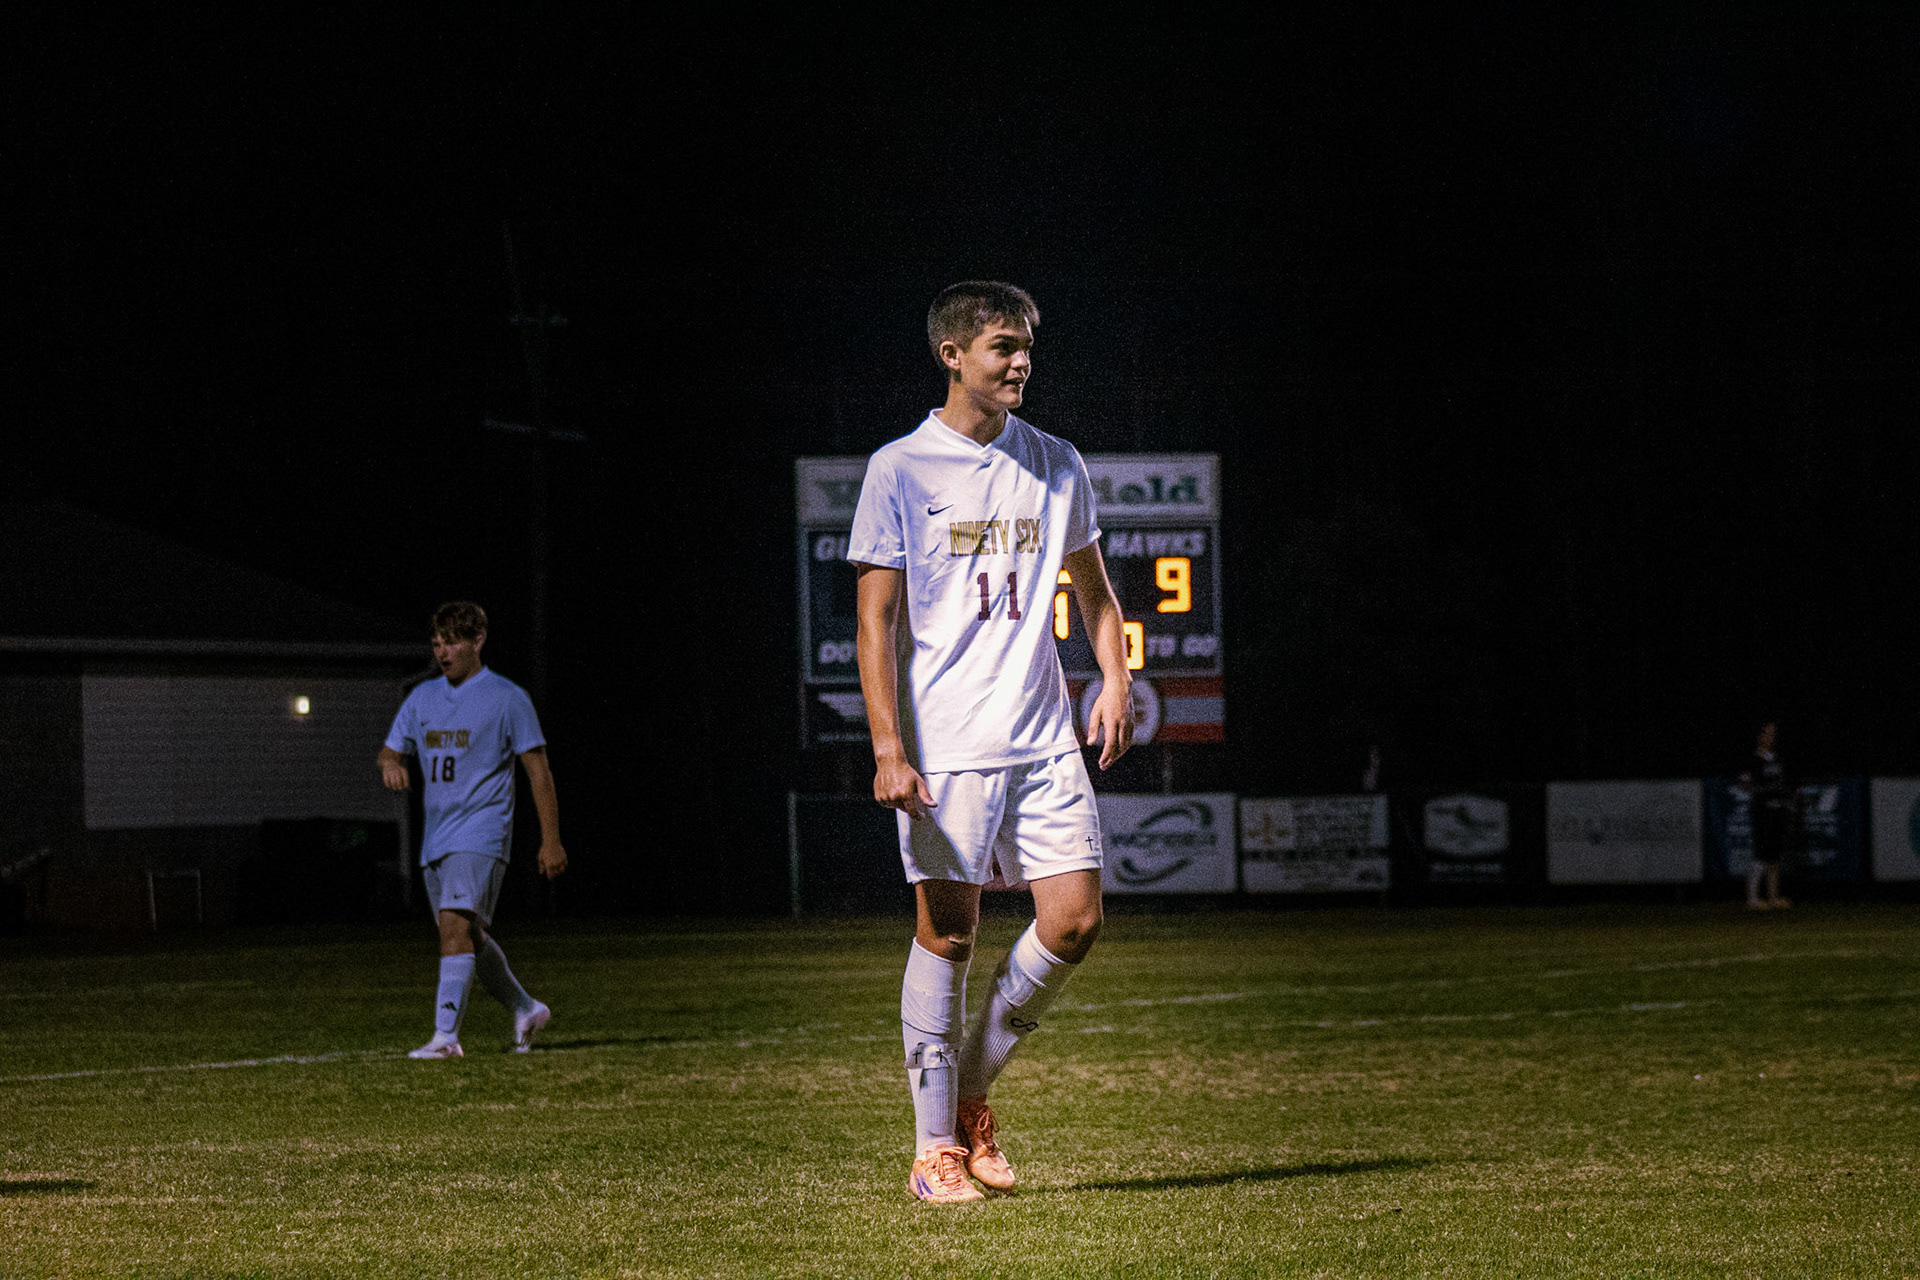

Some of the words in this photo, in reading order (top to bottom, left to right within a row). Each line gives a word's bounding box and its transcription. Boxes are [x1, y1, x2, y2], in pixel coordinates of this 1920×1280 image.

[949, 520, 1010, 557] NINETY
[1015, 518, 1042, 554] SIX
[977, 572, 1021, 620] 11
[1154, 556, 1193, 614] 9
[431, 756, 455, 782] 18
